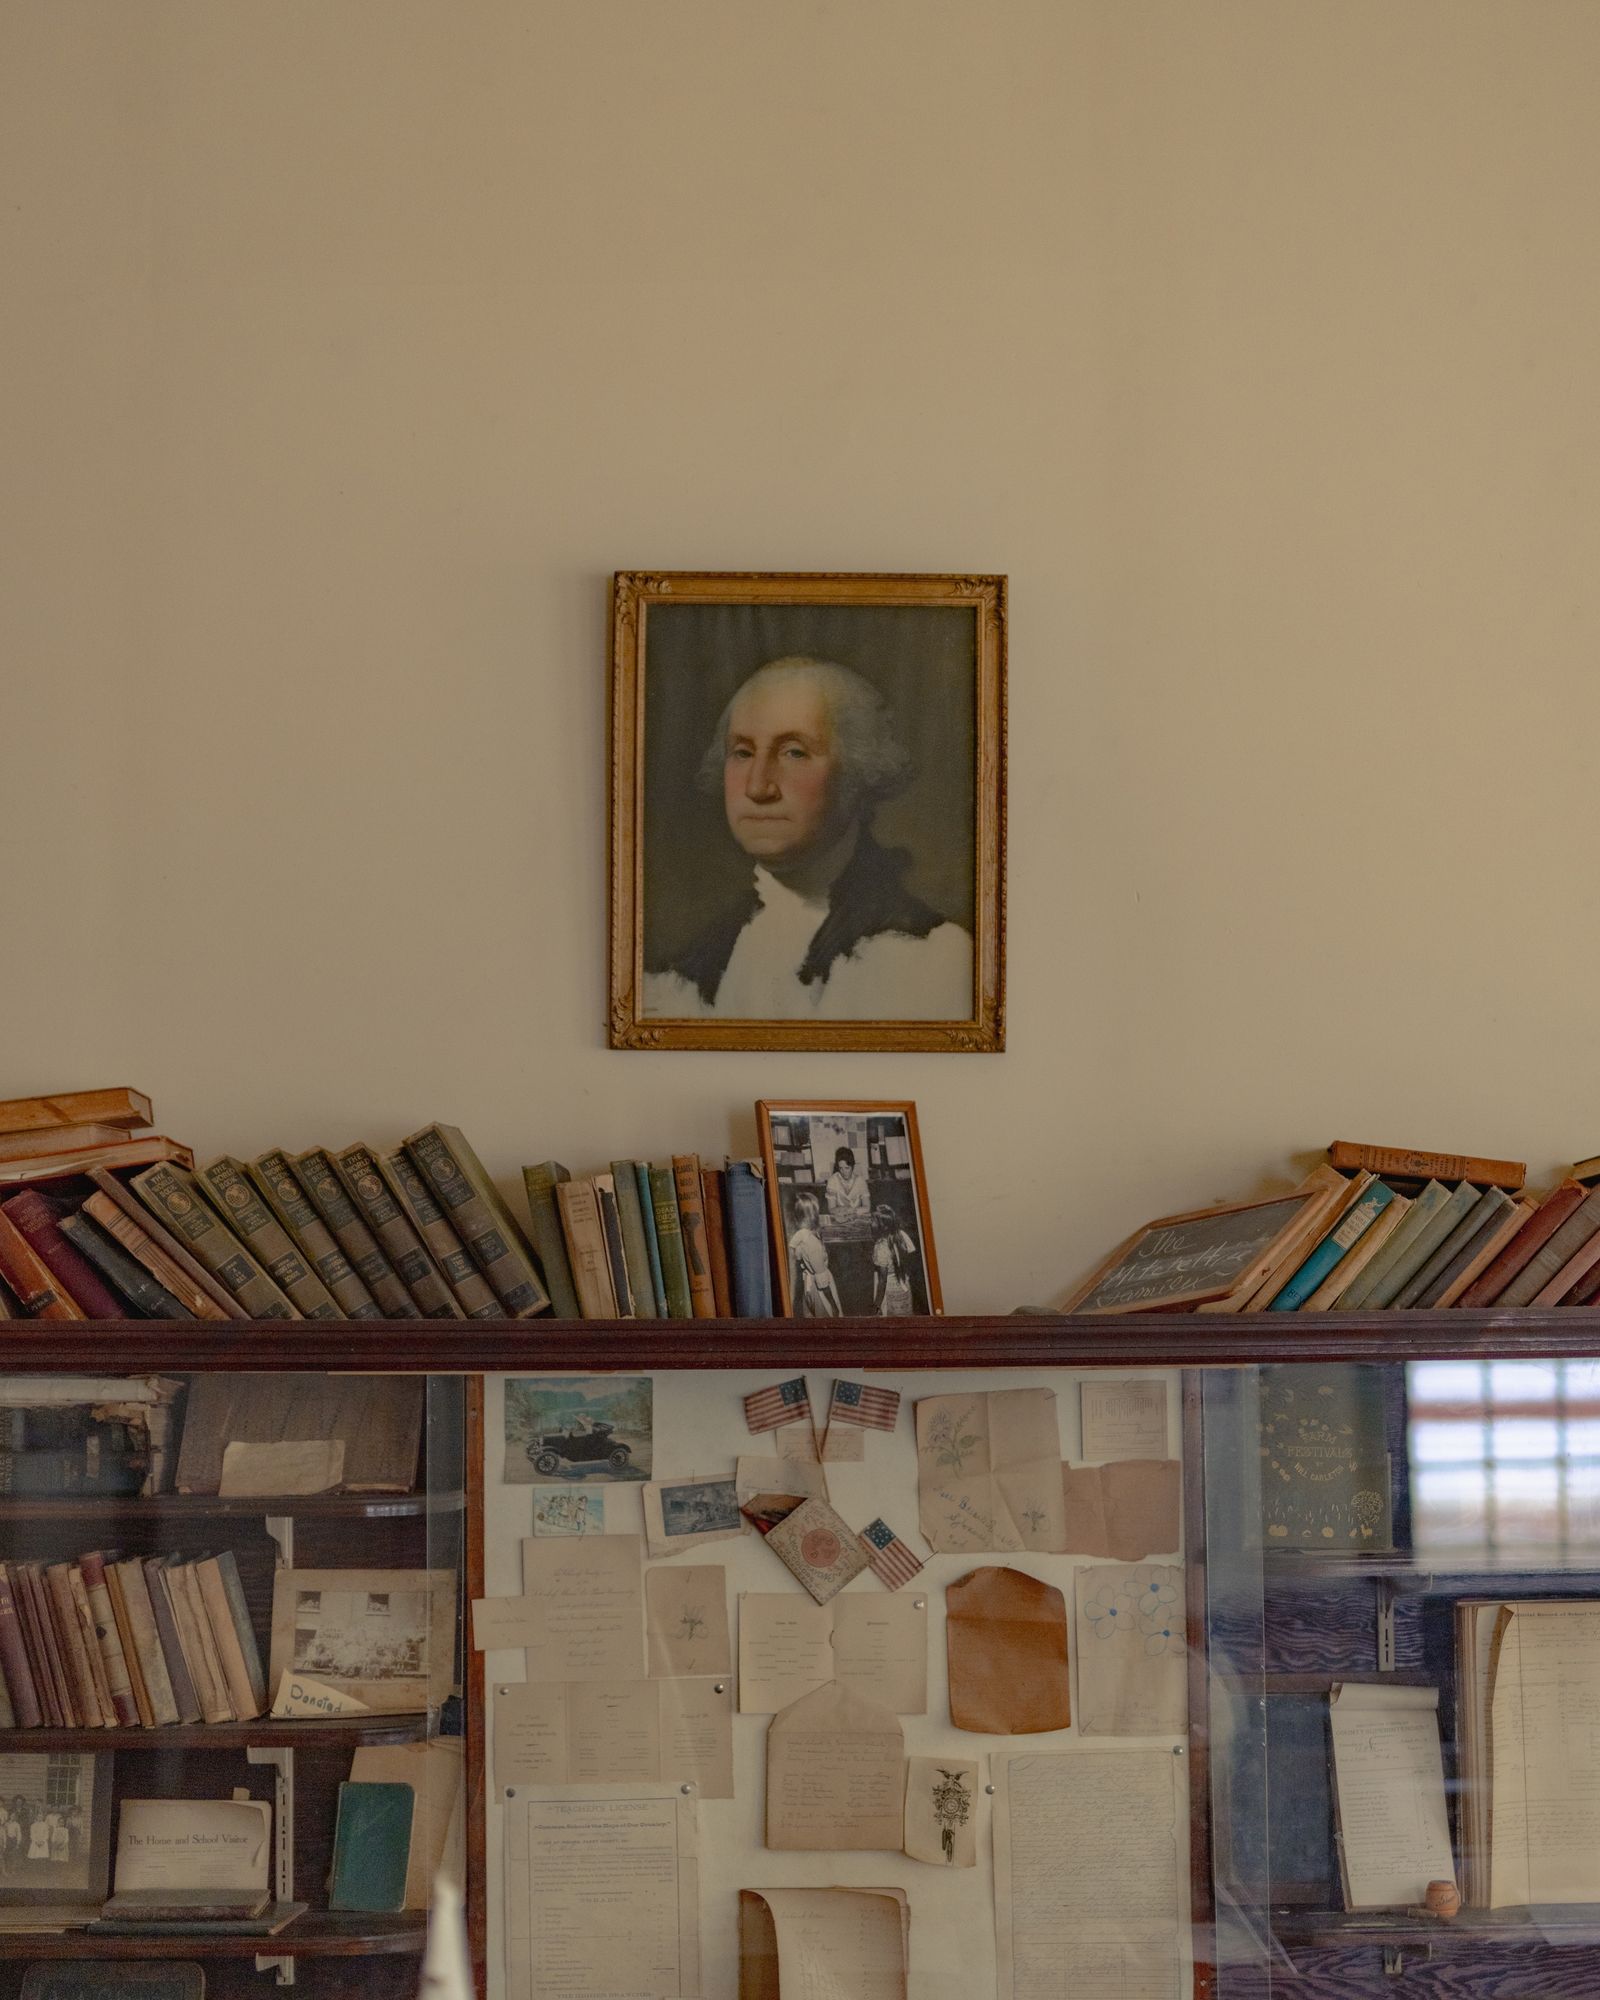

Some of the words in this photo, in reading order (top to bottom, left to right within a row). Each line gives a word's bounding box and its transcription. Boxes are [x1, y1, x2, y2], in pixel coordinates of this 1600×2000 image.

[347, 1152, 363, 1164] THE
[211, 1162, 228, 1175] THE
[345, 1159, 369, 1175] WORLD
[213, 1168, 235, 1184] WORLD
[353, 1169, 372, 1181] BOOK
[219, 1177, 238, 1189] BOOK
[655, 1206, 675, 1215] DEAR
[1138, 1229, 1196, 1258] The
[1300, 1430, 1338, 1445] FARM
[1287, 1446, 1353, 1457] FESTIVALS
[290, 1683, 343, 1713] Donated
[608, 1803, 649, 1812] LICENSE
[128, 1835, 144, 1845] The
[146, 1835, 172, 1845] Home
[175, 1834, 189, 1845] and
[191, 1833, 218, 1844] School
[221, 1833, 249, 1844] Visitor
